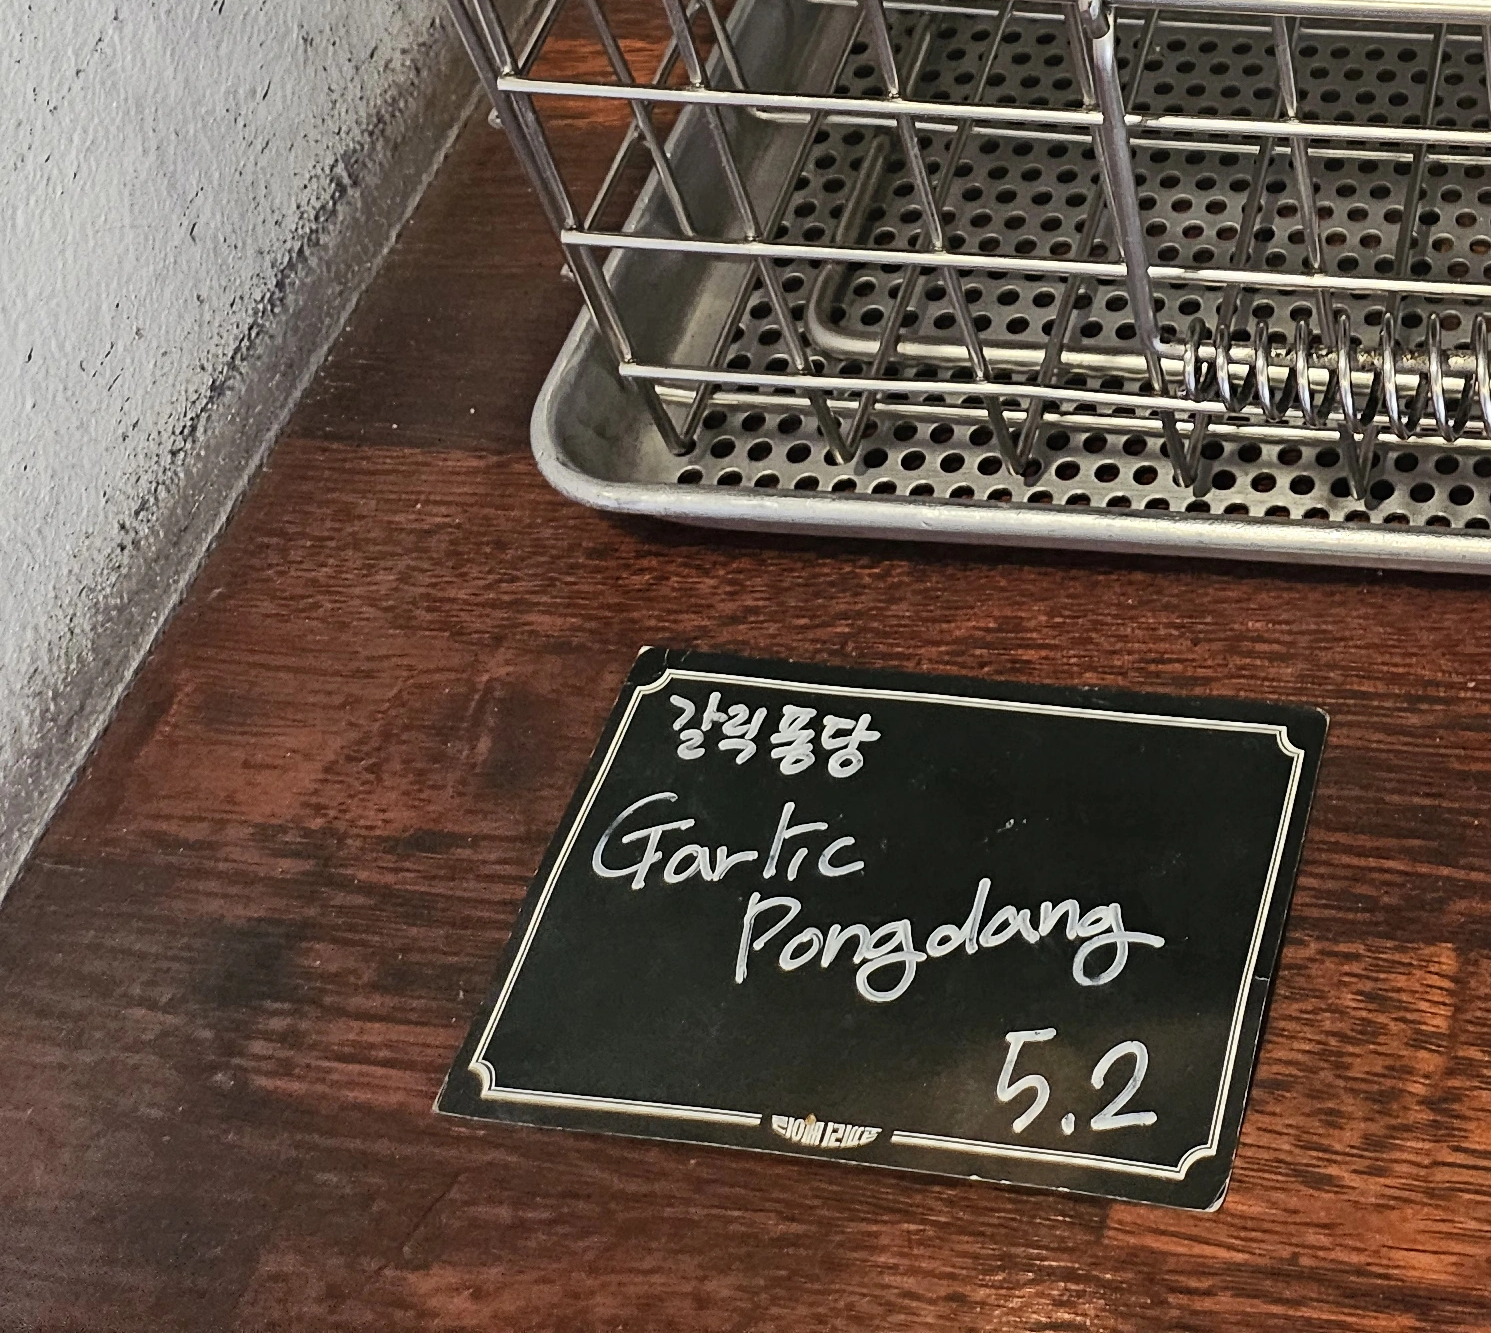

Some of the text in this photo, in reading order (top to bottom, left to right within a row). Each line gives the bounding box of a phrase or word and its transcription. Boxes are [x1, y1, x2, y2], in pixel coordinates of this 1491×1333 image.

[591, 791, 866, 890] Garlic
[735, 878, 1165, 1002] Pongdang
[996, 1027, 1158, 1136] 5.2
